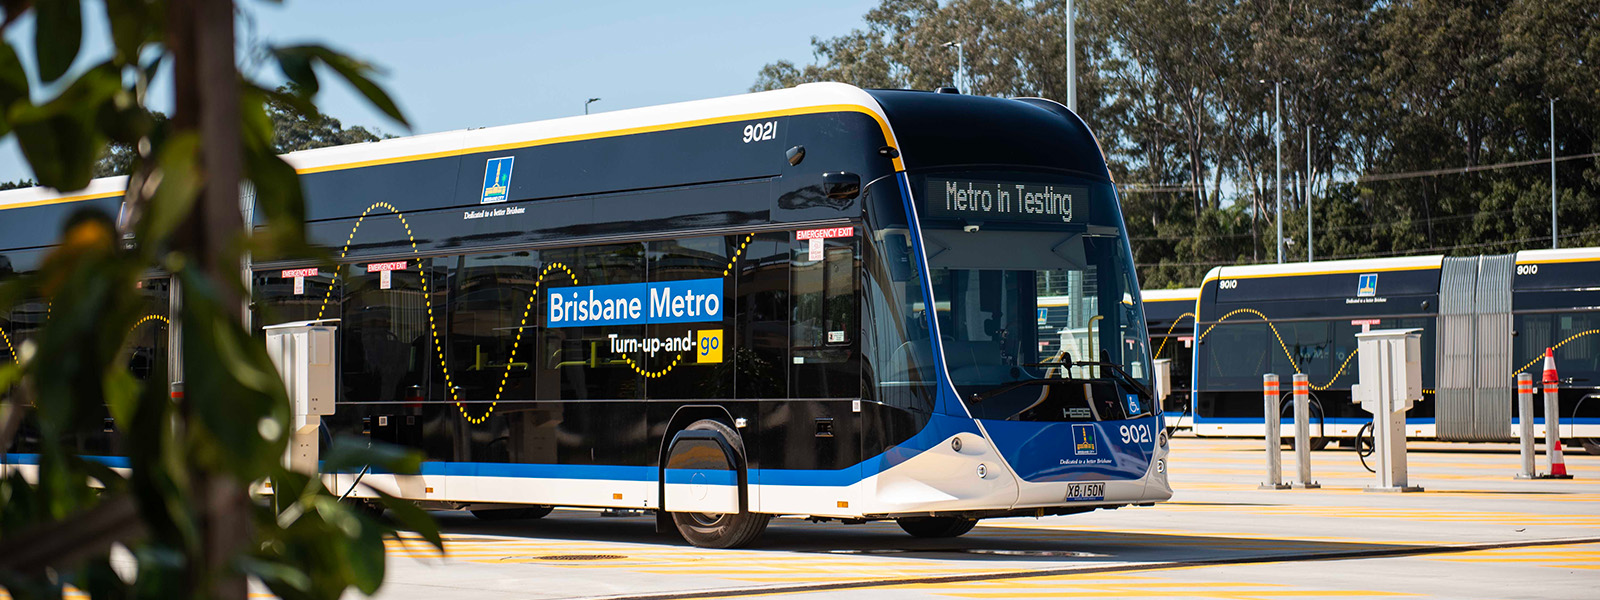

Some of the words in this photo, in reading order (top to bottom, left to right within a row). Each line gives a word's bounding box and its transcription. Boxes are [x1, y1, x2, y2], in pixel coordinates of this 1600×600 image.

[743, 121, 777, 143] 9021
[946, 181, 992, 212] Metro
[997, 183, 1010, 213] in
[1015, 184, 1072, 222] Testing
[797, 229, 837, 239] EMERGENCY
[838, 227, 853, 237] EXIT
[367, 262, 396, 271] EMERGENCY
[397, 261, 407, 270] EXIT
[1516, 265, 1538, 275] 9010
[1220, 280, 1237, 289] 9010
[550, 290, 642, 322] Brisbane
[650, 287, 719, 318] Metro
[1063, 408, 1091, 418] HESS
[1120, 424, 1153, 444] 9021
